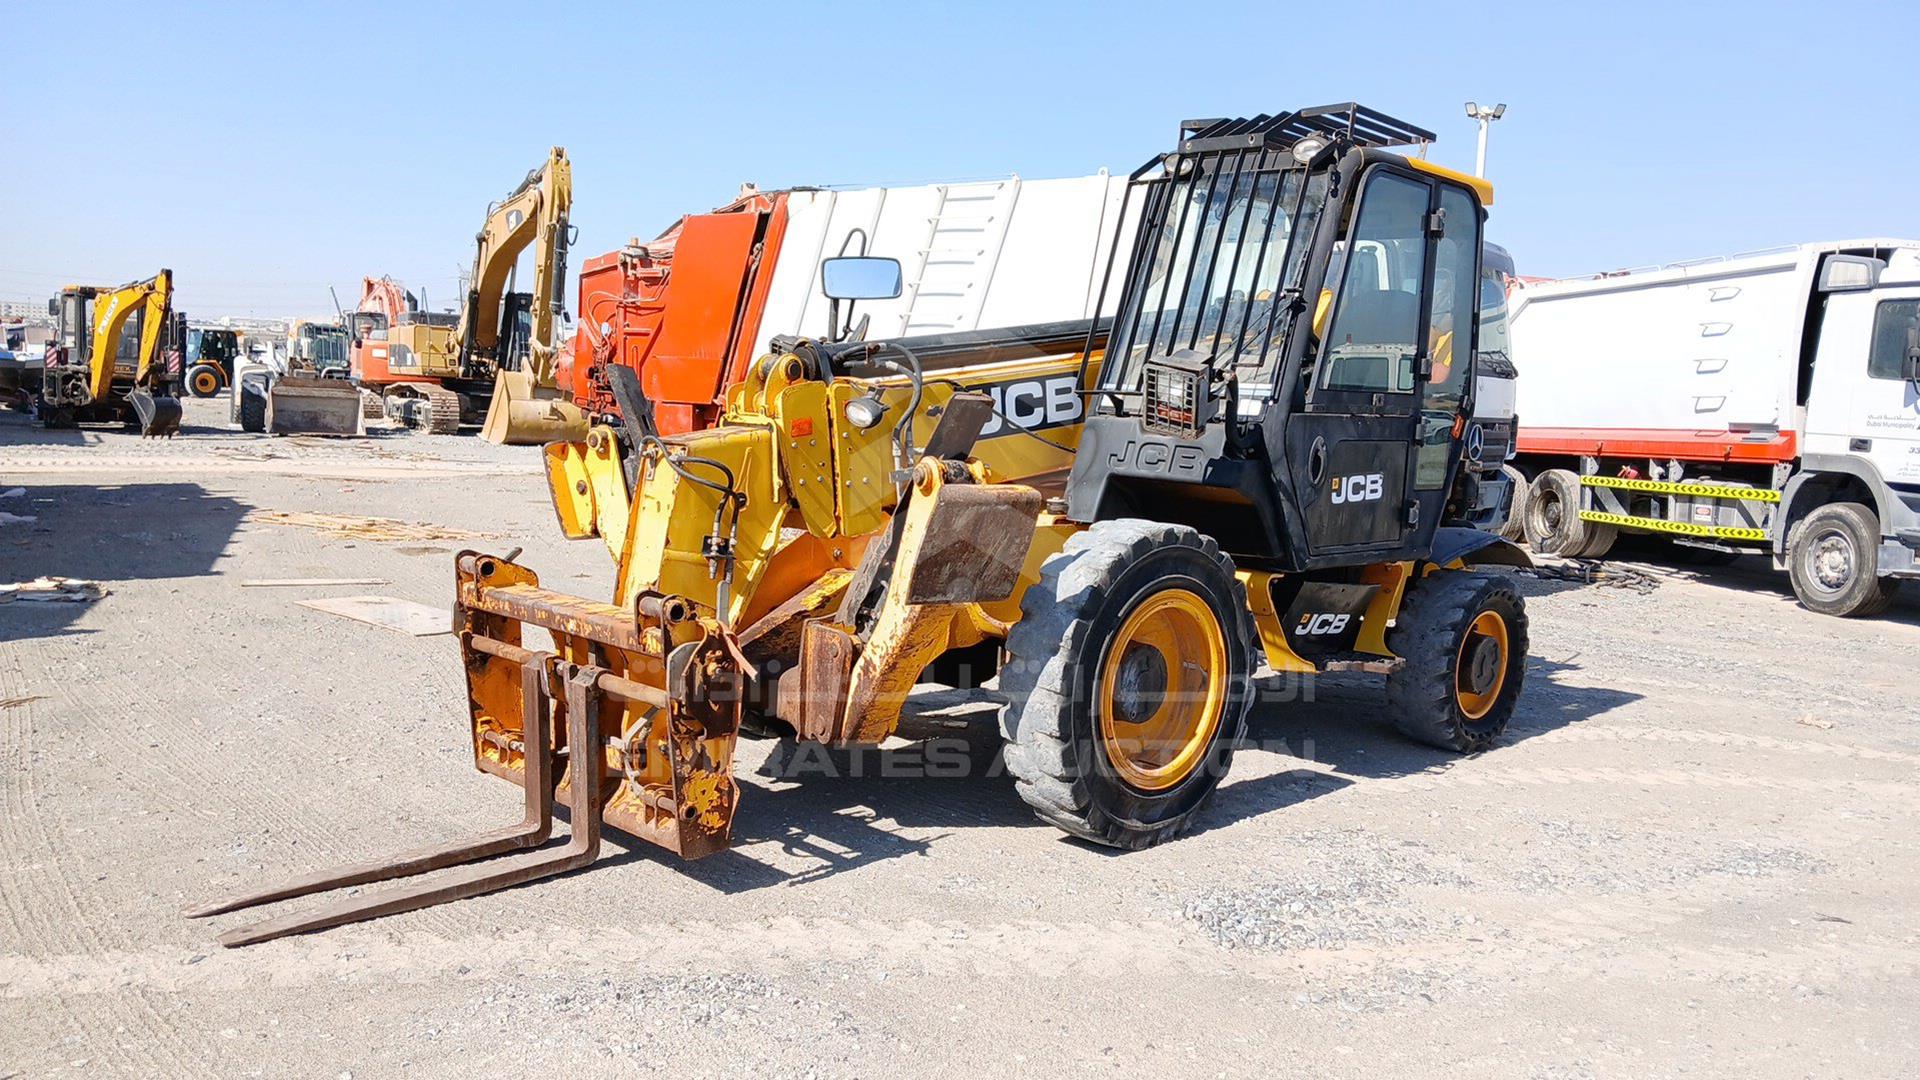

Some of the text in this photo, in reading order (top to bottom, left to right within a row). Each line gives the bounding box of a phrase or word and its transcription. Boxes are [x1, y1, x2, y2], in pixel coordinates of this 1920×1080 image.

[979, 376, 1083, 435] JCB
[1107, 440, 1206, 473] JCB
[1331, 473, 1383, 504] JCB
[1295, 613, 1350, 635] JCB
